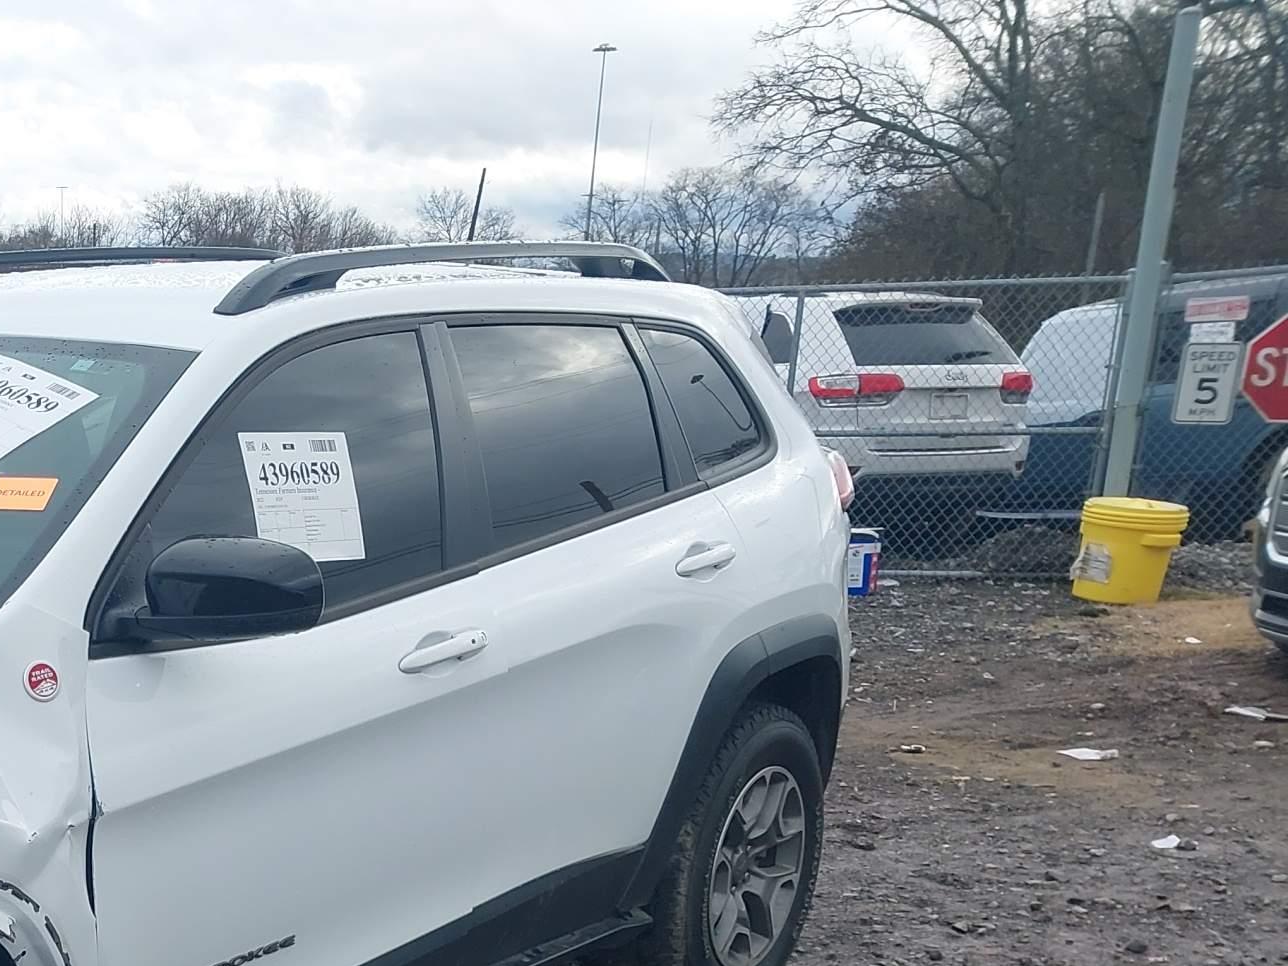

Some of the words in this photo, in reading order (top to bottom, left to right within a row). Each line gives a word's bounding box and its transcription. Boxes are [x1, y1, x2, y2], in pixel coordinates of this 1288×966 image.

[1190, 351, 1236, 362] SPEED
[1192, 363, 1230, 374] LIMIT
[1250, 347, 1288, 387] S
[1194, 377, 1219, 405] 5
[258, 461, 340, 486] 43960589
[31, 667, 51, 677] TRAIL
[31, 672, 54, 682] RATED
